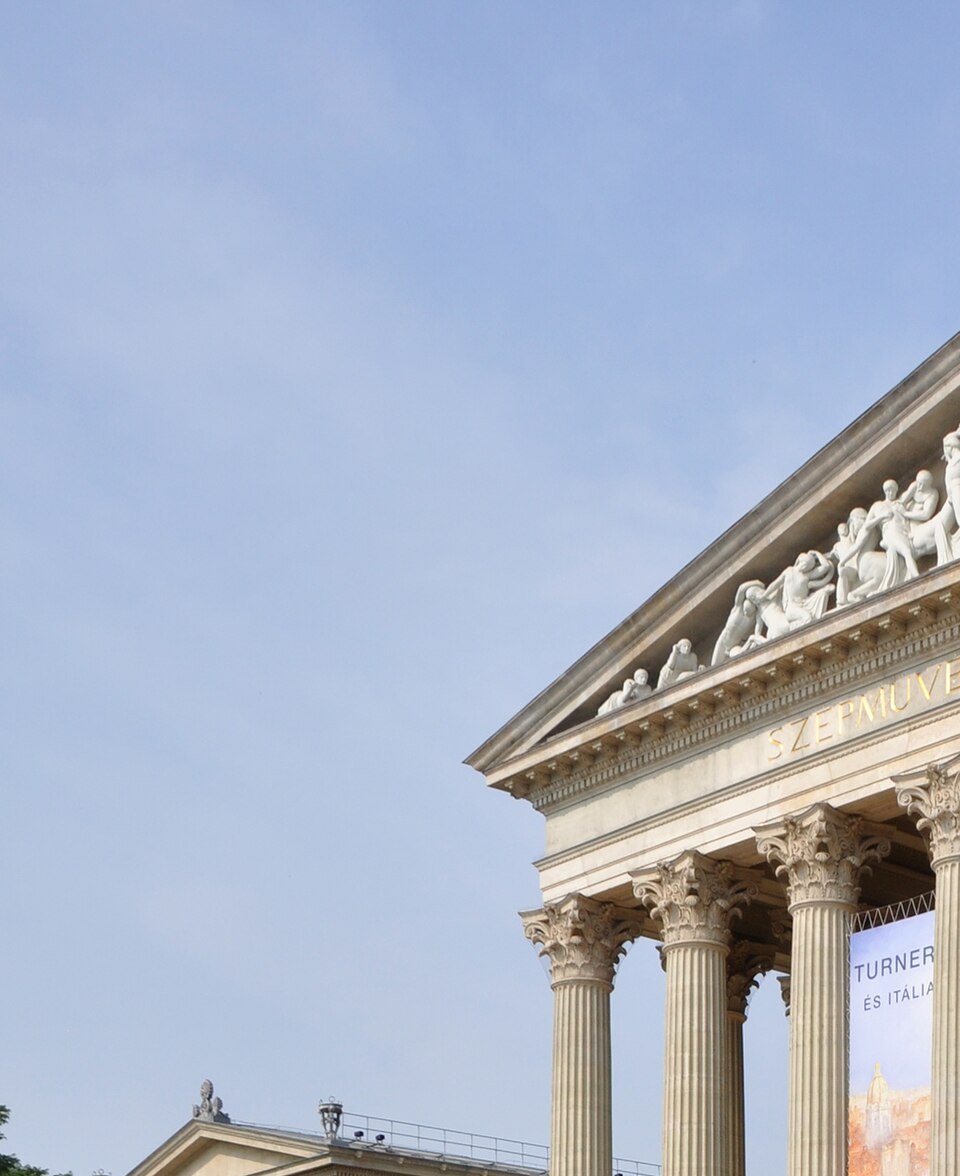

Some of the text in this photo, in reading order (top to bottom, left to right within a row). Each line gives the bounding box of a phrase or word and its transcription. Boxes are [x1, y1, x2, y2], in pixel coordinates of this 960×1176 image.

[854, 945, 934, 982] TURNER
[864, 981, 934, 1011] ÉS ITÁLIA
